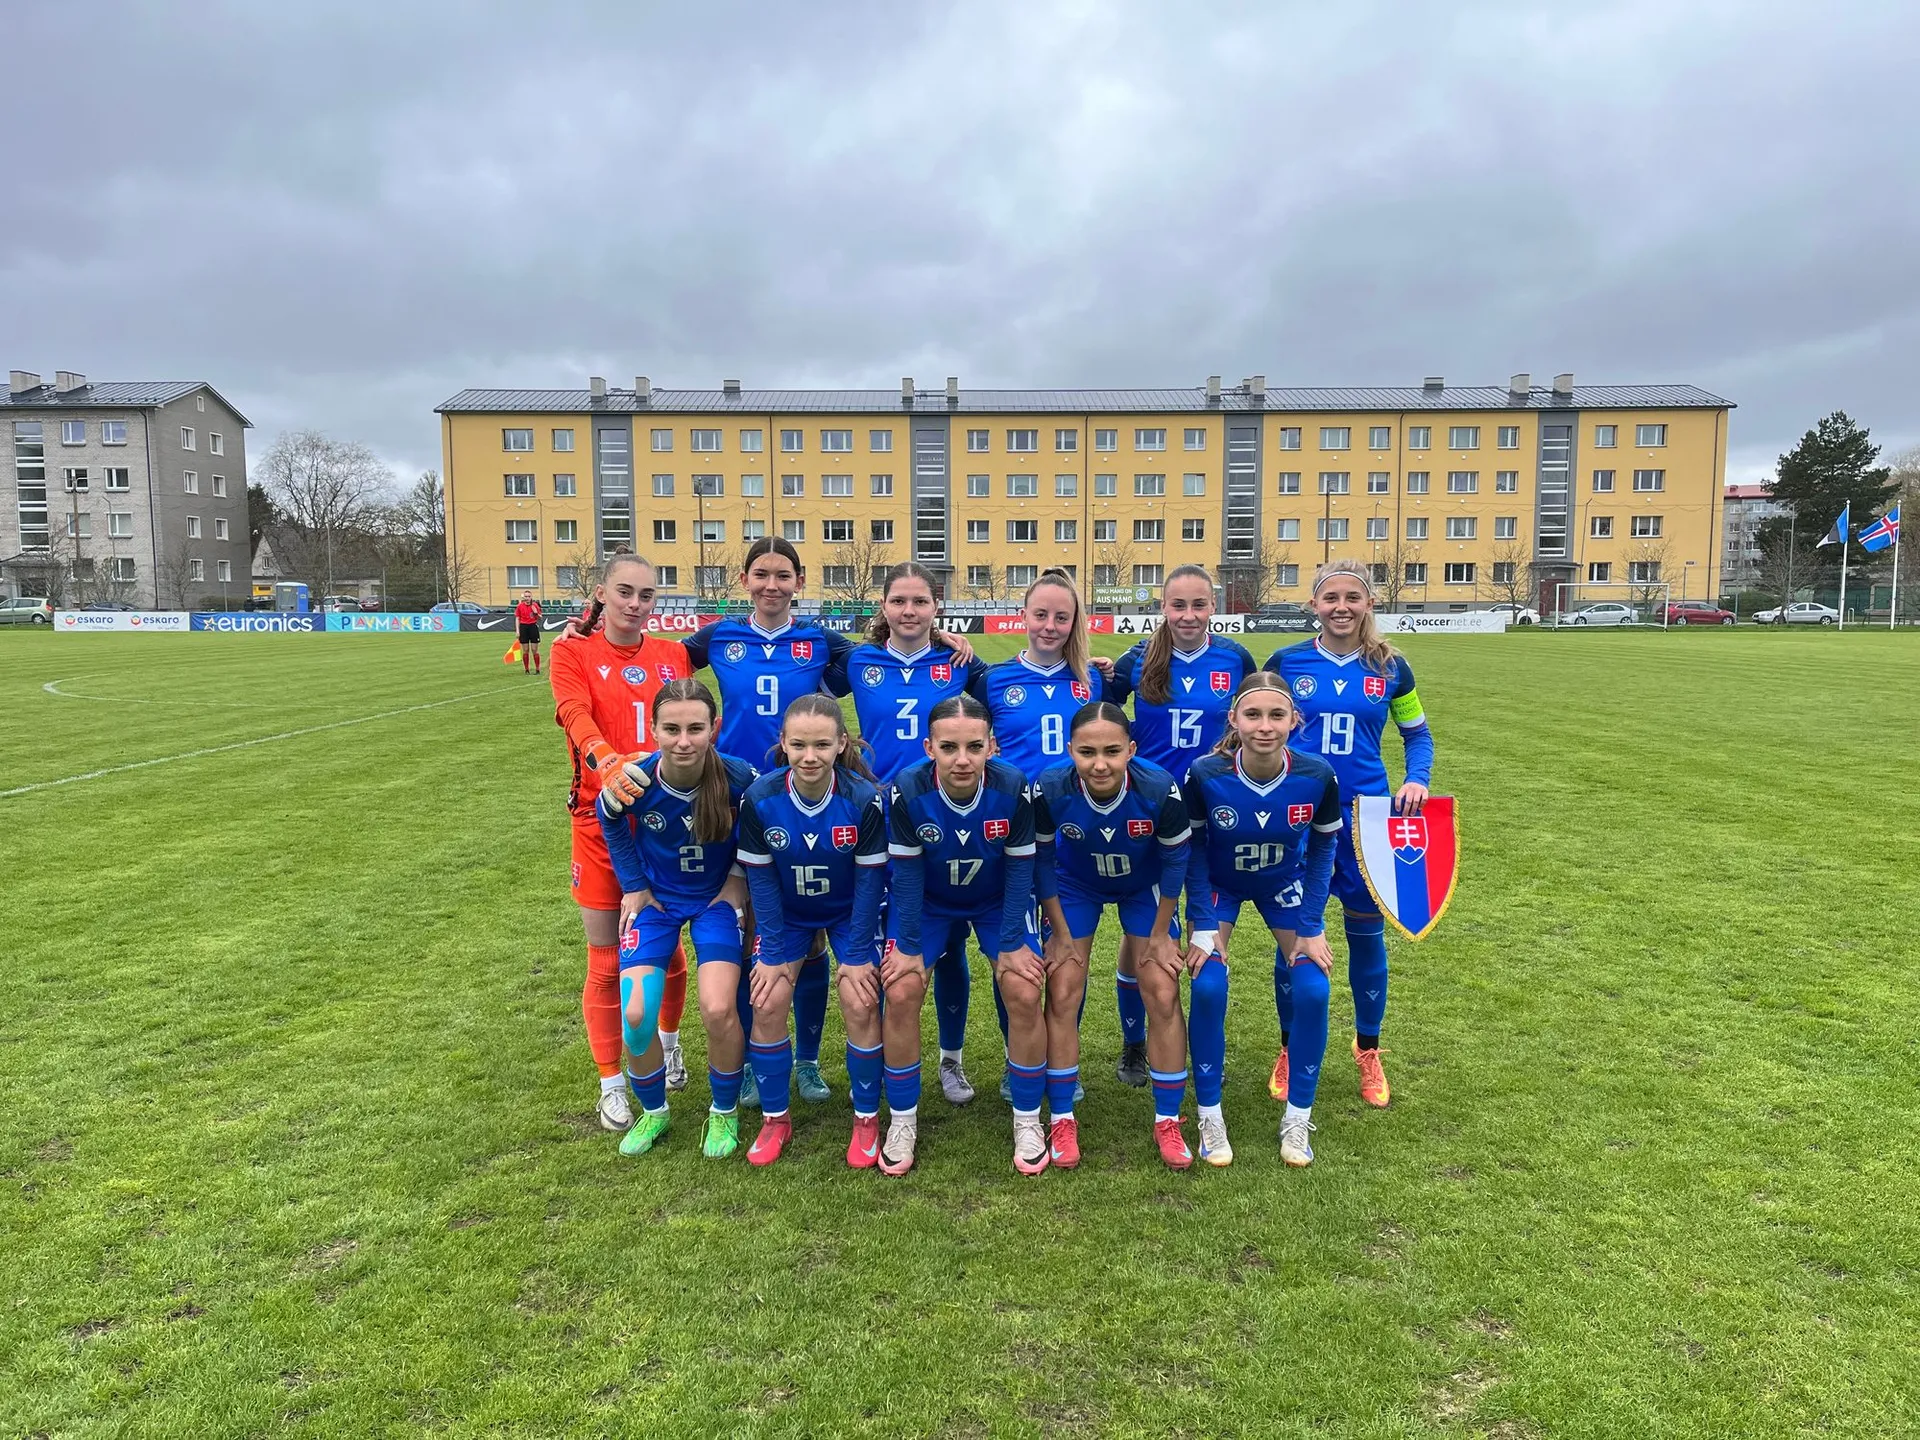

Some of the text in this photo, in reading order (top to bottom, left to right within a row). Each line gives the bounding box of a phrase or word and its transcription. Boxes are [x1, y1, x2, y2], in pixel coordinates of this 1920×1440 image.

[77, 616, 114, 624] eskaro
[143, 616, 179, 624] eskaro
[218, 613, 313, 632] euronics
[1416, 618, 1482, 626] soccernet.ee
[756, 675, 778, 716] 9
[632, 701, 645, 743] 1
[896, 698, 919, 740] 3
[1168, 708, 1203, 749] 13
[1319, 712, 1355, 755] 19
[1041, 714, 1064, 755] 8
[679, 845, 705, 873] 2
[946, 858, 984, 886] 17
[1091, 853, 1131, 877] 10
[1234, 843, 1284, 872] 20
[791, 865, 830, 896] 15
